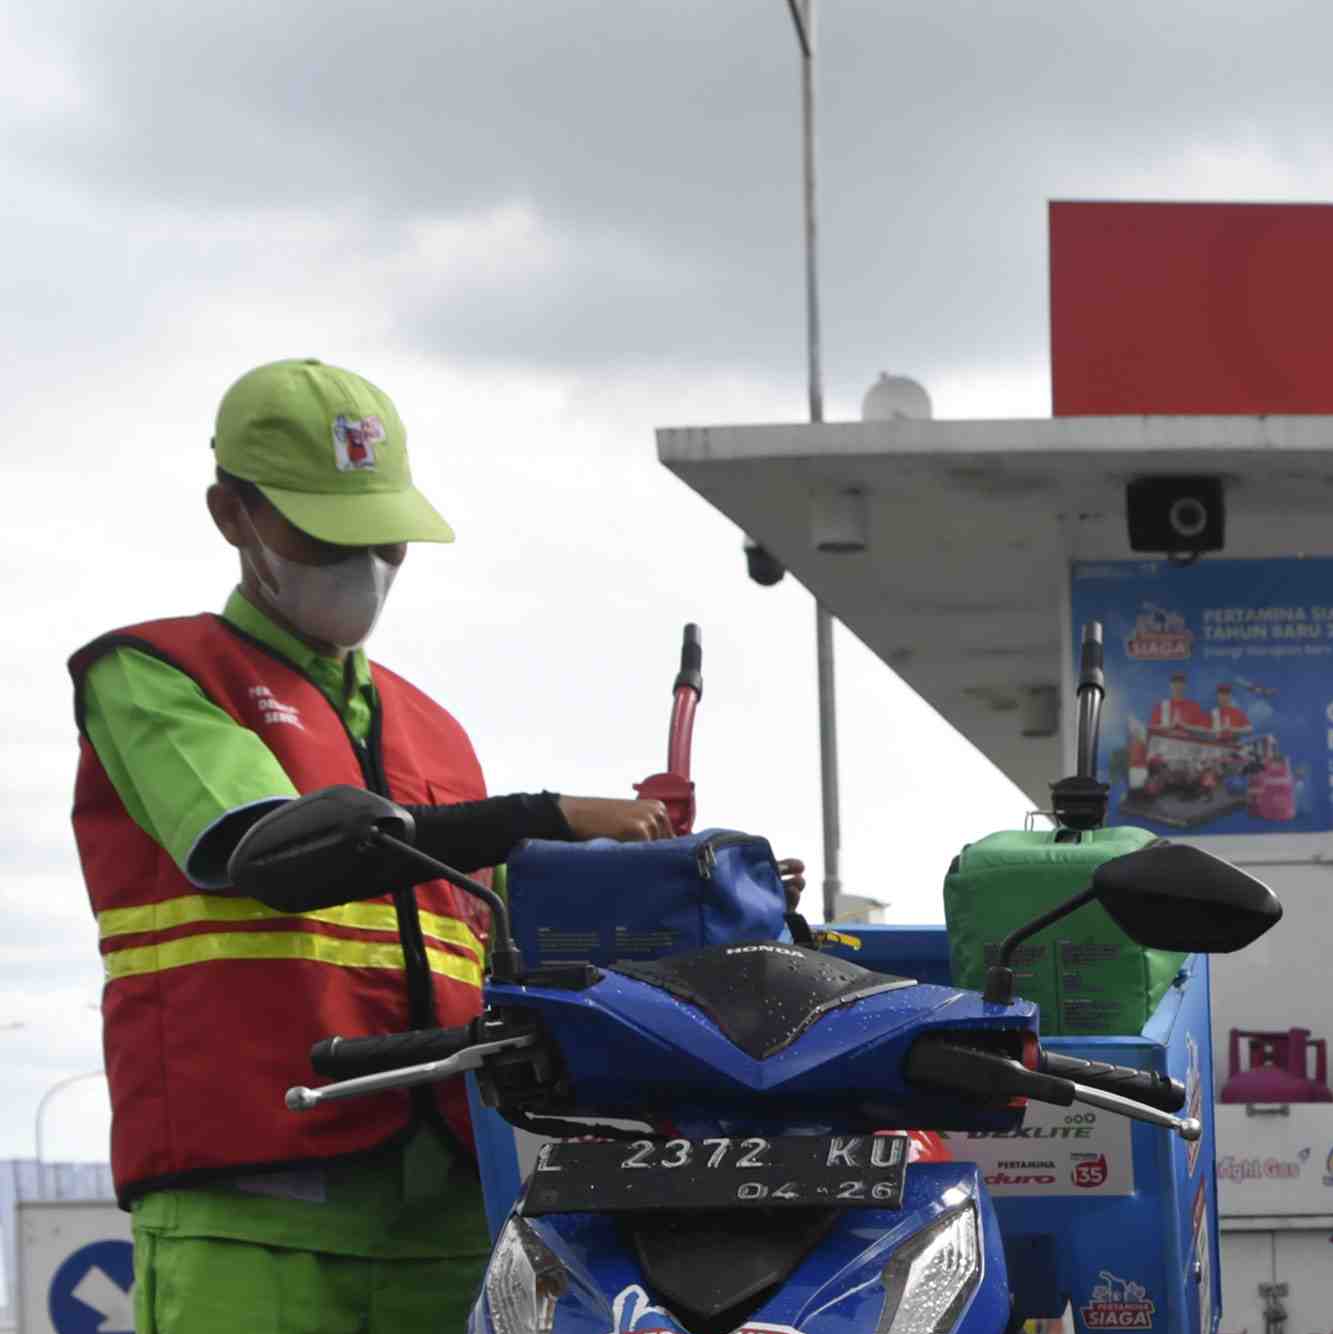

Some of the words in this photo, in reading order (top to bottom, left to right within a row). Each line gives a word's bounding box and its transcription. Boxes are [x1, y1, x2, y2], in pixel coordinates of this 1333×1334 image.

[726, 945, 806, 959] HONDA
[536, 1144, 562, 1171] L
[621, 1138, 770, 1168] 2372
[826, 1137, 900, 1168] KU
[1216, 1157, 1262, 1184] right
[1089, 1312, 1147, 1327] SIAGA
